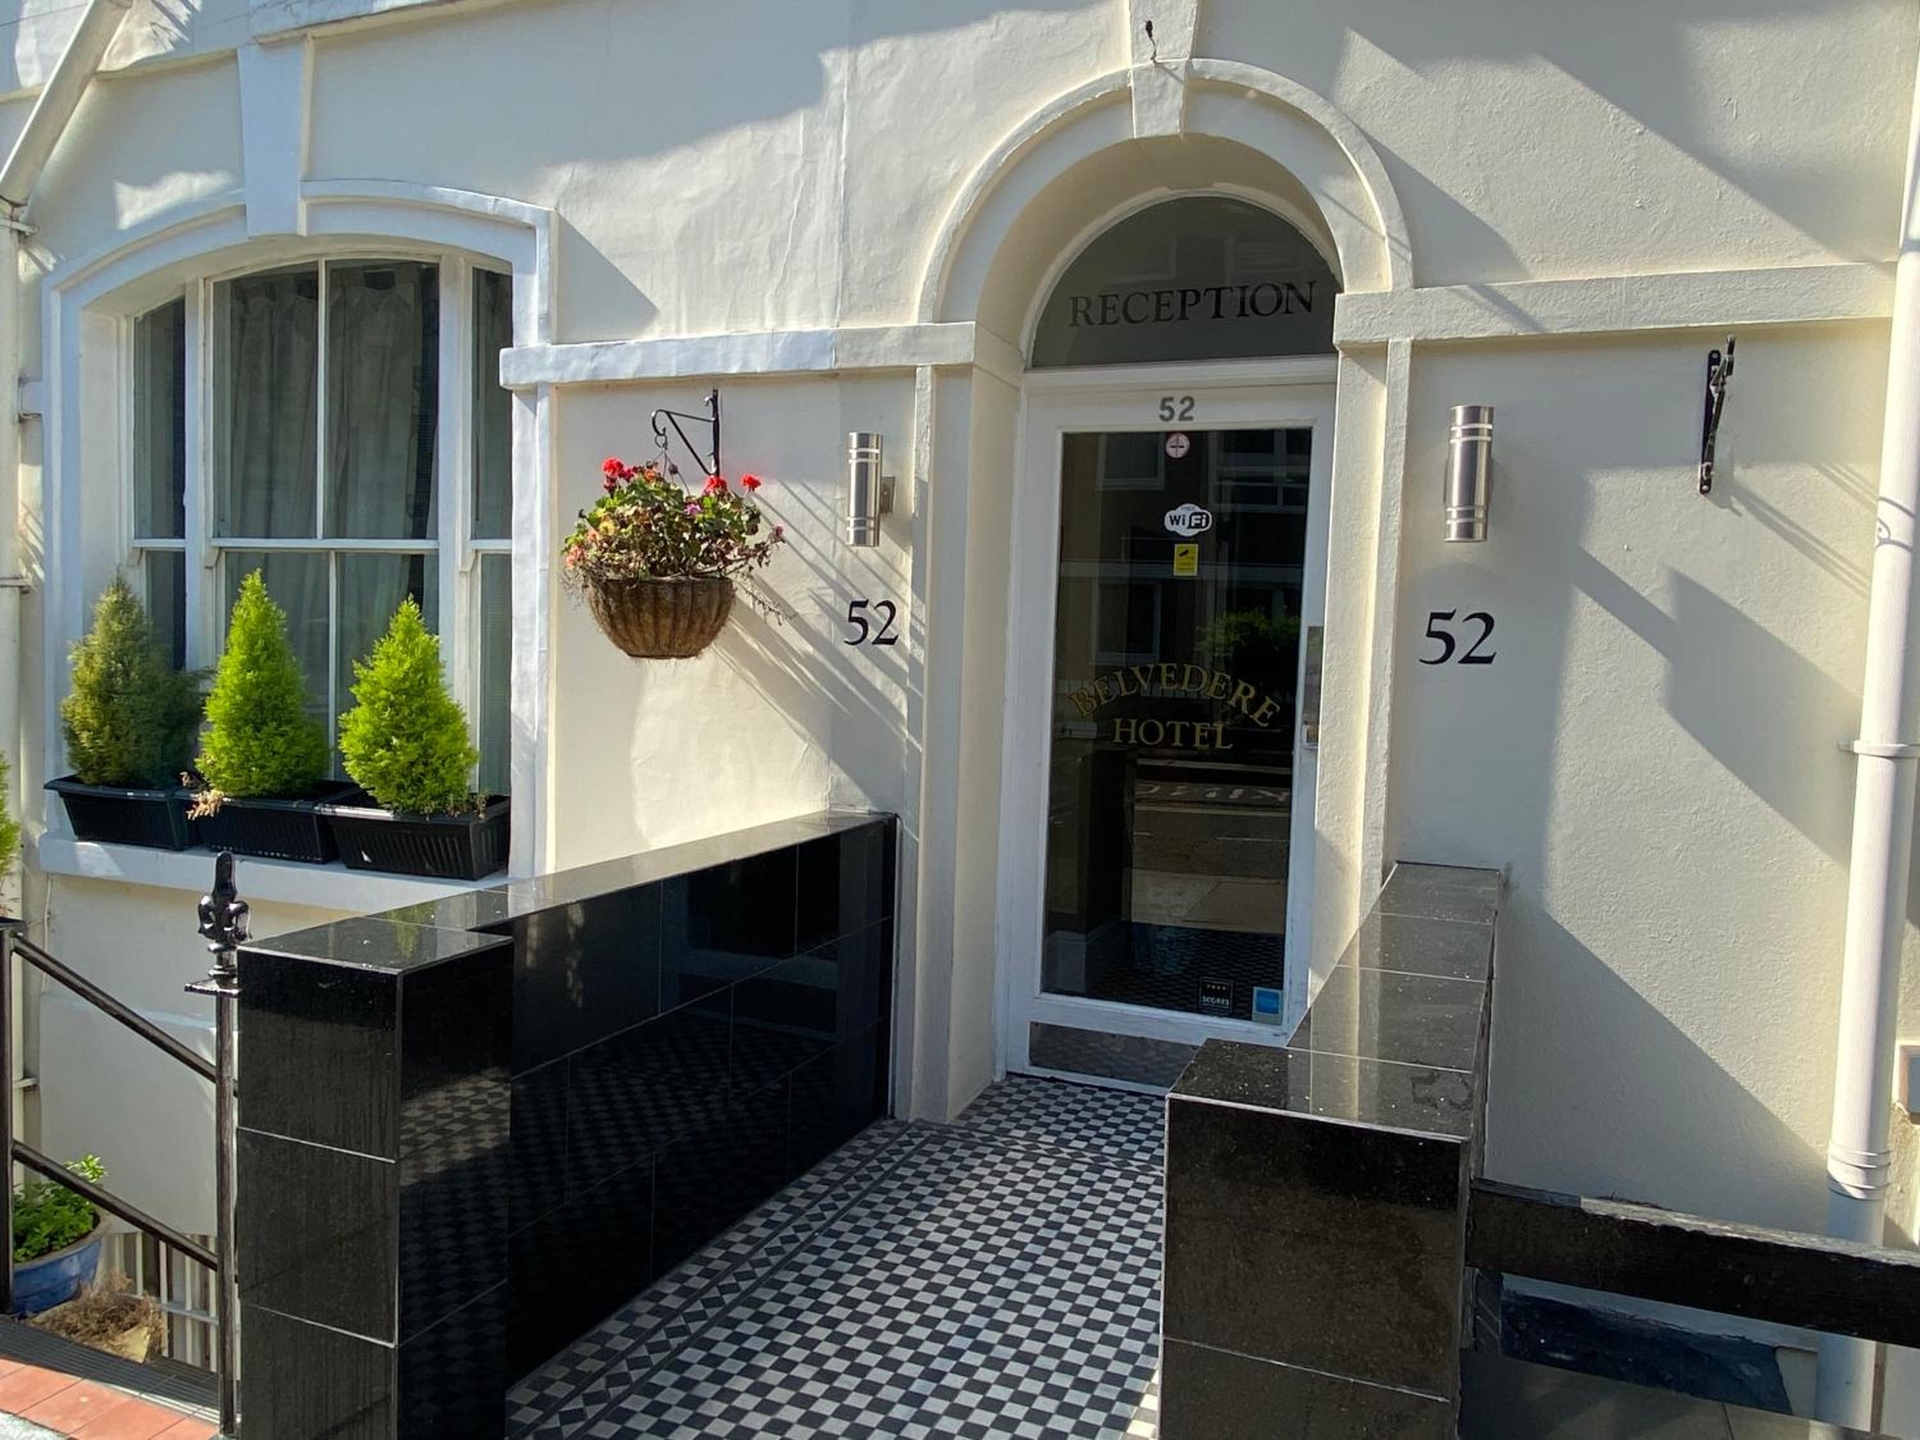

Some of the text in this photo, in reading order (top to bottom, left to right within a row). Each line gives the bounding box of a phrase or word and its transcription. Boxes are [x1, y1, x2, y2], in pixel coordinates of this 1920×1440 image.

[1069, 281, 1316, 327] RECEPTION
[1159, 396, 1195, 421] 52
[845, 599, 899, 646] 52
[1419, 608, 1498, 665] 52
[1068, 663, 1281, 727] BELVEDERE
[1112, 717, 1234, 750] HOTEL
